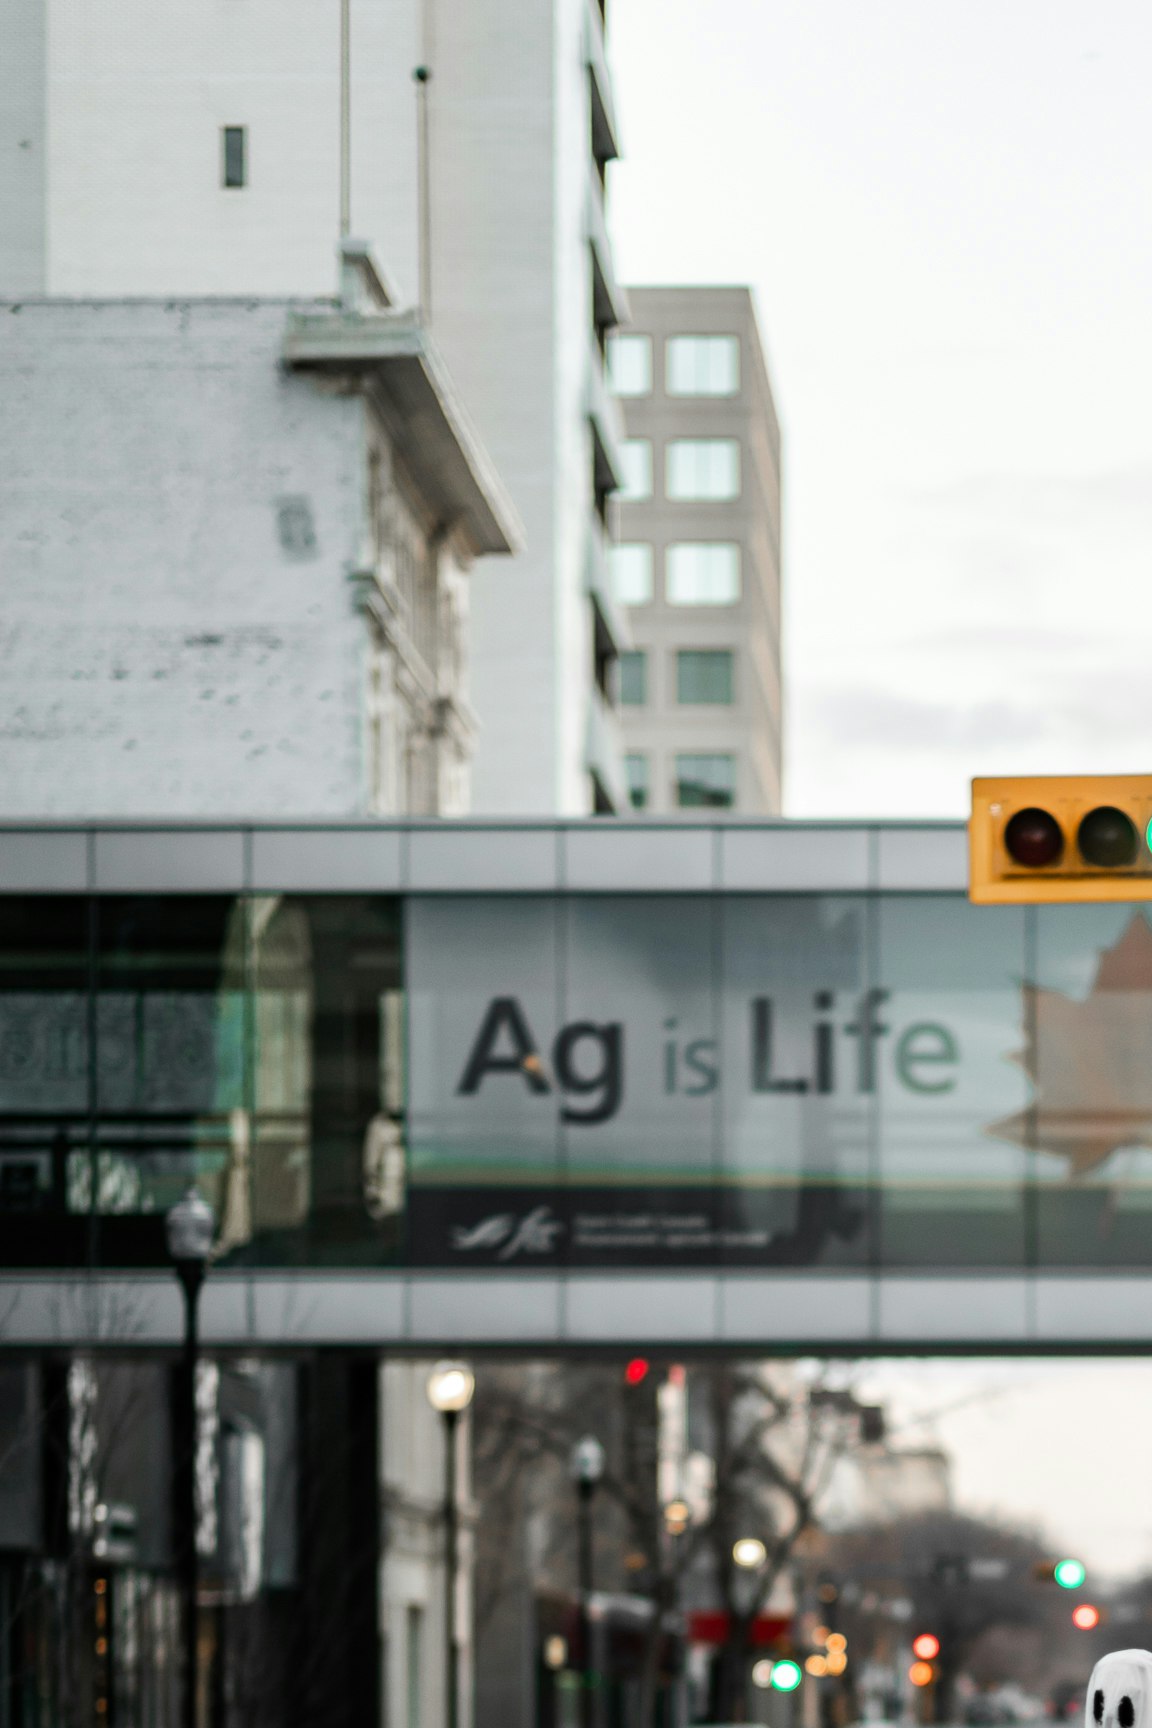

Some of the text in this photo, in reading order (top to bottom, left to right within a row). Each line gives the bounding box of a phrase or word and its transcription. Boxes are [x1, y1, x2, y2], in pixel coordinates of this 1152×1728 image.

[456, 989, 960, 1124] Ag is Life
